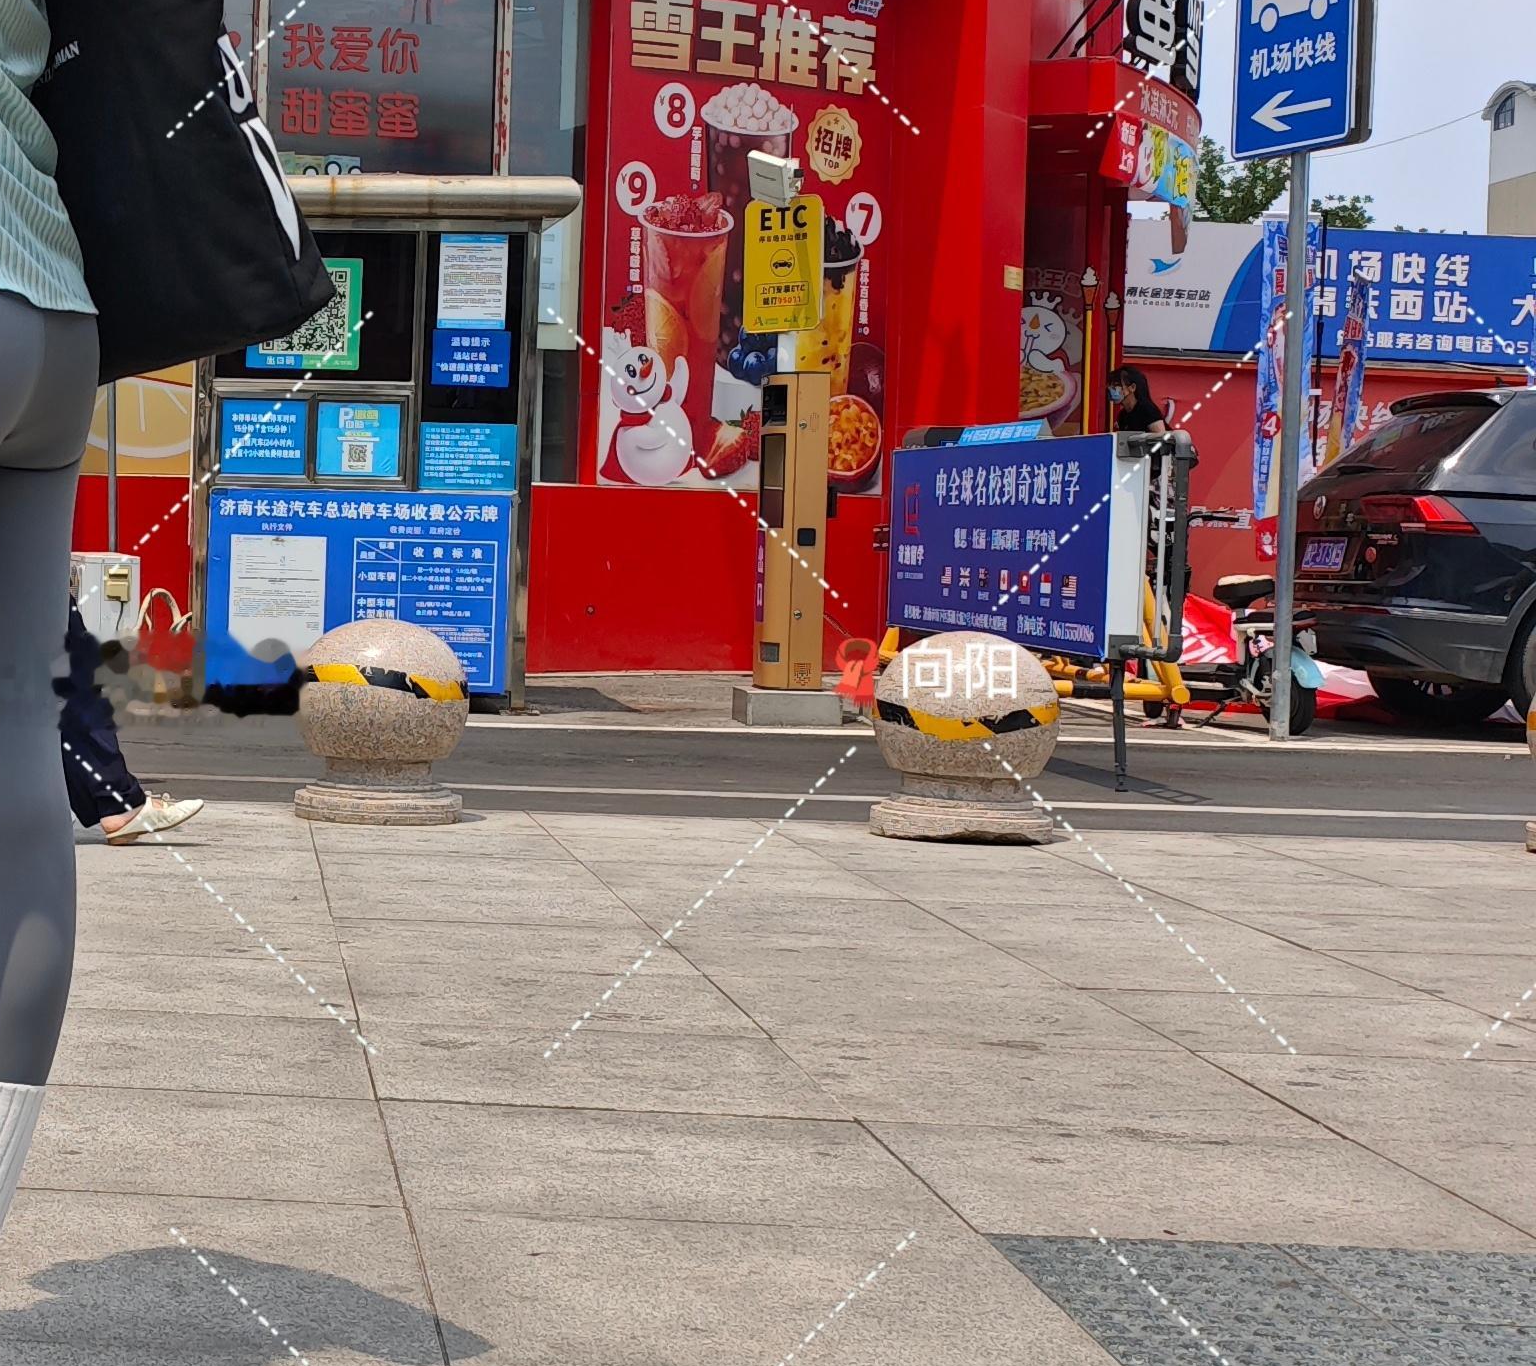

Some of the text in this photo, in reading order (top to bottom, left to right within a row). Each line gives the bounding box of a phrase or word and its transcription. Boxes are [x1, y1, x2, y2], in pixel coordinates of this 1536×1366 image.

[282, 22, 420, 74] 我爱你
[1249, 31, 1337, 80] 机场快线
[281, 87, 419, 139] 甜蜜蜜
[814, 126, 852, 161] 招牌
[824, 157, 840, 169] TOP
[760, 204, 808, 232] ETC
[265, 355, 295, 366] 出口码
[935, 461, 1081, 507] 申全球名校到奇迹留学
[219, 499, 499, 523] 济南长途汽车总站停车场收费公示牌
[261, 522, 294, 532] 执行文件
[413, 546, 483, 560] 收费标准
[357, 571, 397, 582] 小型车辆
[356, 597, 396, 609] 中型车辆
